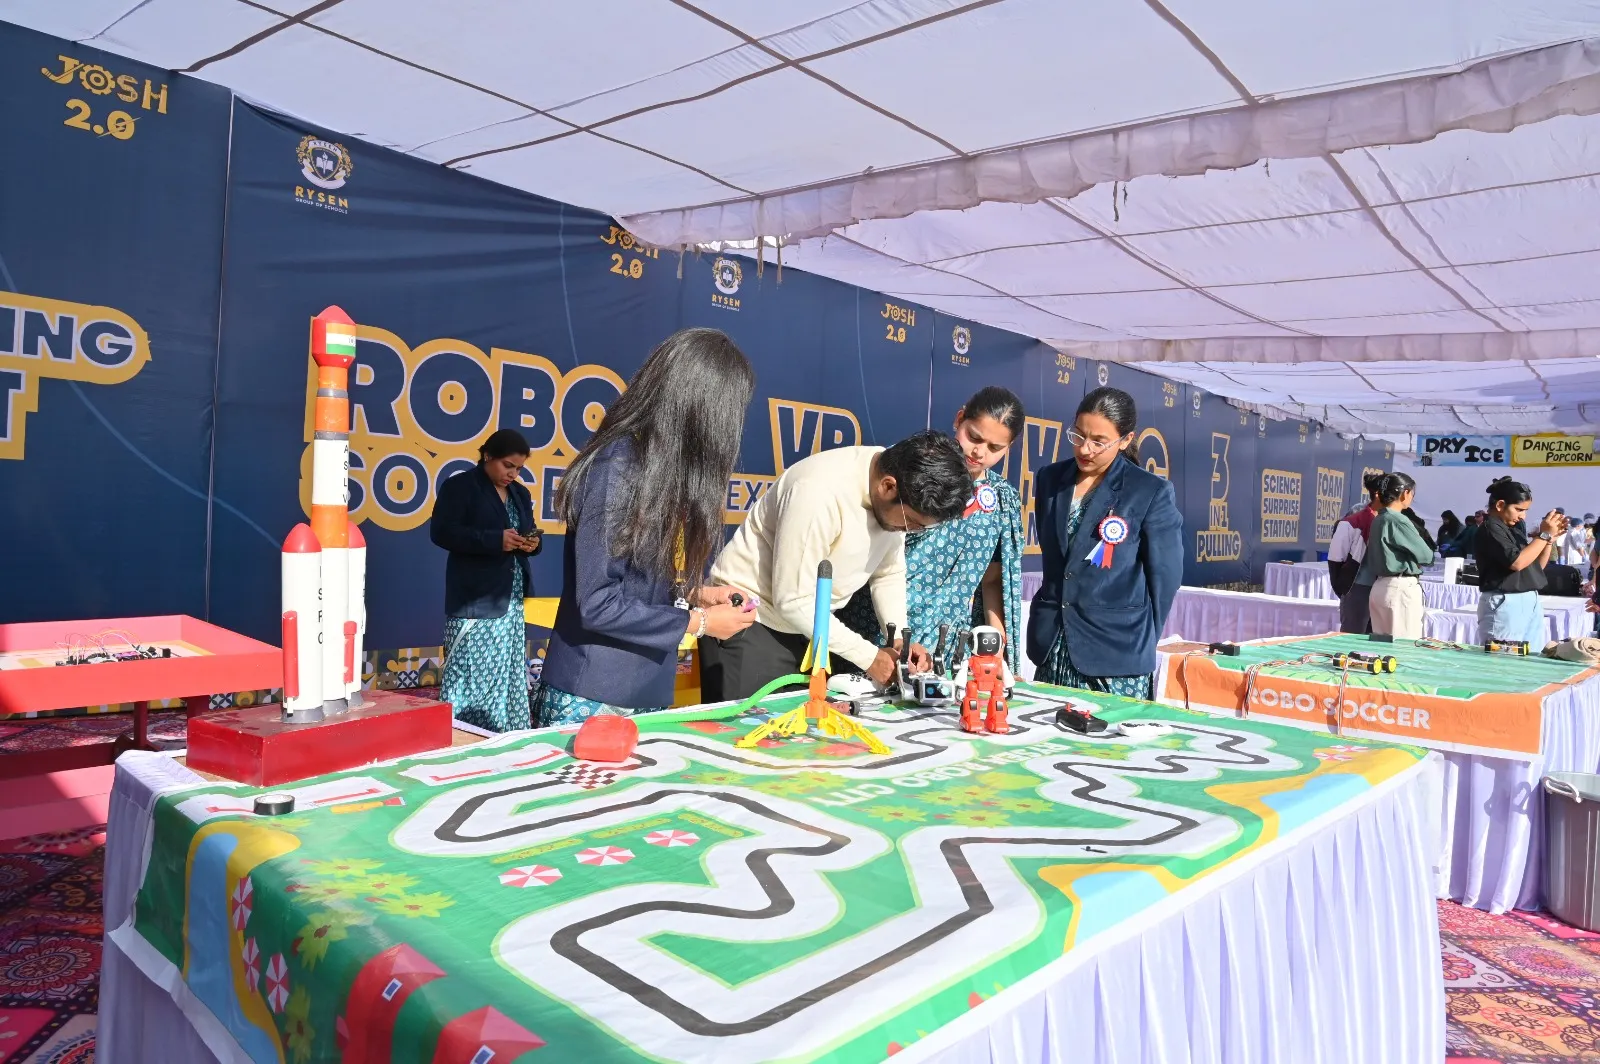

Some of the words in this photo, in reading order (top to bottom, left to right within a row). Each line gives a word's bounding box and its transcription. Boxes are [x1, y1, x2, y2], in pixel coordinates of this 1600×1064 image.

[41, 54, 168, 115] JOSH
[63, 98, 140, 140] 2.0
[295, 185, 349, 209] RYSEN
[295, 197, 314, 206] GROUP
[324, 204, 348, 215] SCHOOLS
[600, 226, 659, 259] JO
[610, 253, 645, 279] 2.0
[712, 294, 741, 307] RYSEN
[881, 303, 916, 327] JOSH
[885, 324, 907, 343] 2.0
[1055, 354, 1076, 370] JOSH
[1057, 370, 1070, 384] 2.0
[1425, 438, 1467, 453] DRY
[1464, 445, 1504, 463] ICE
[1523, 439, 1581, 451] DANCING
[1210, 432, 1230, 502] 3
[1545, 452, 1593, 463] POPCORN
[1263, 473, 1300, 496] SCIENCE
[1318, 472, 1343, 498] FOAM
[1263, 497, 1299, 516] SURPRISE
[1263, 519, 1298, 538] STATION
[1197, 531, 1241, 560] PULLING
[1323, 697, 1431, 730] SOCCER
